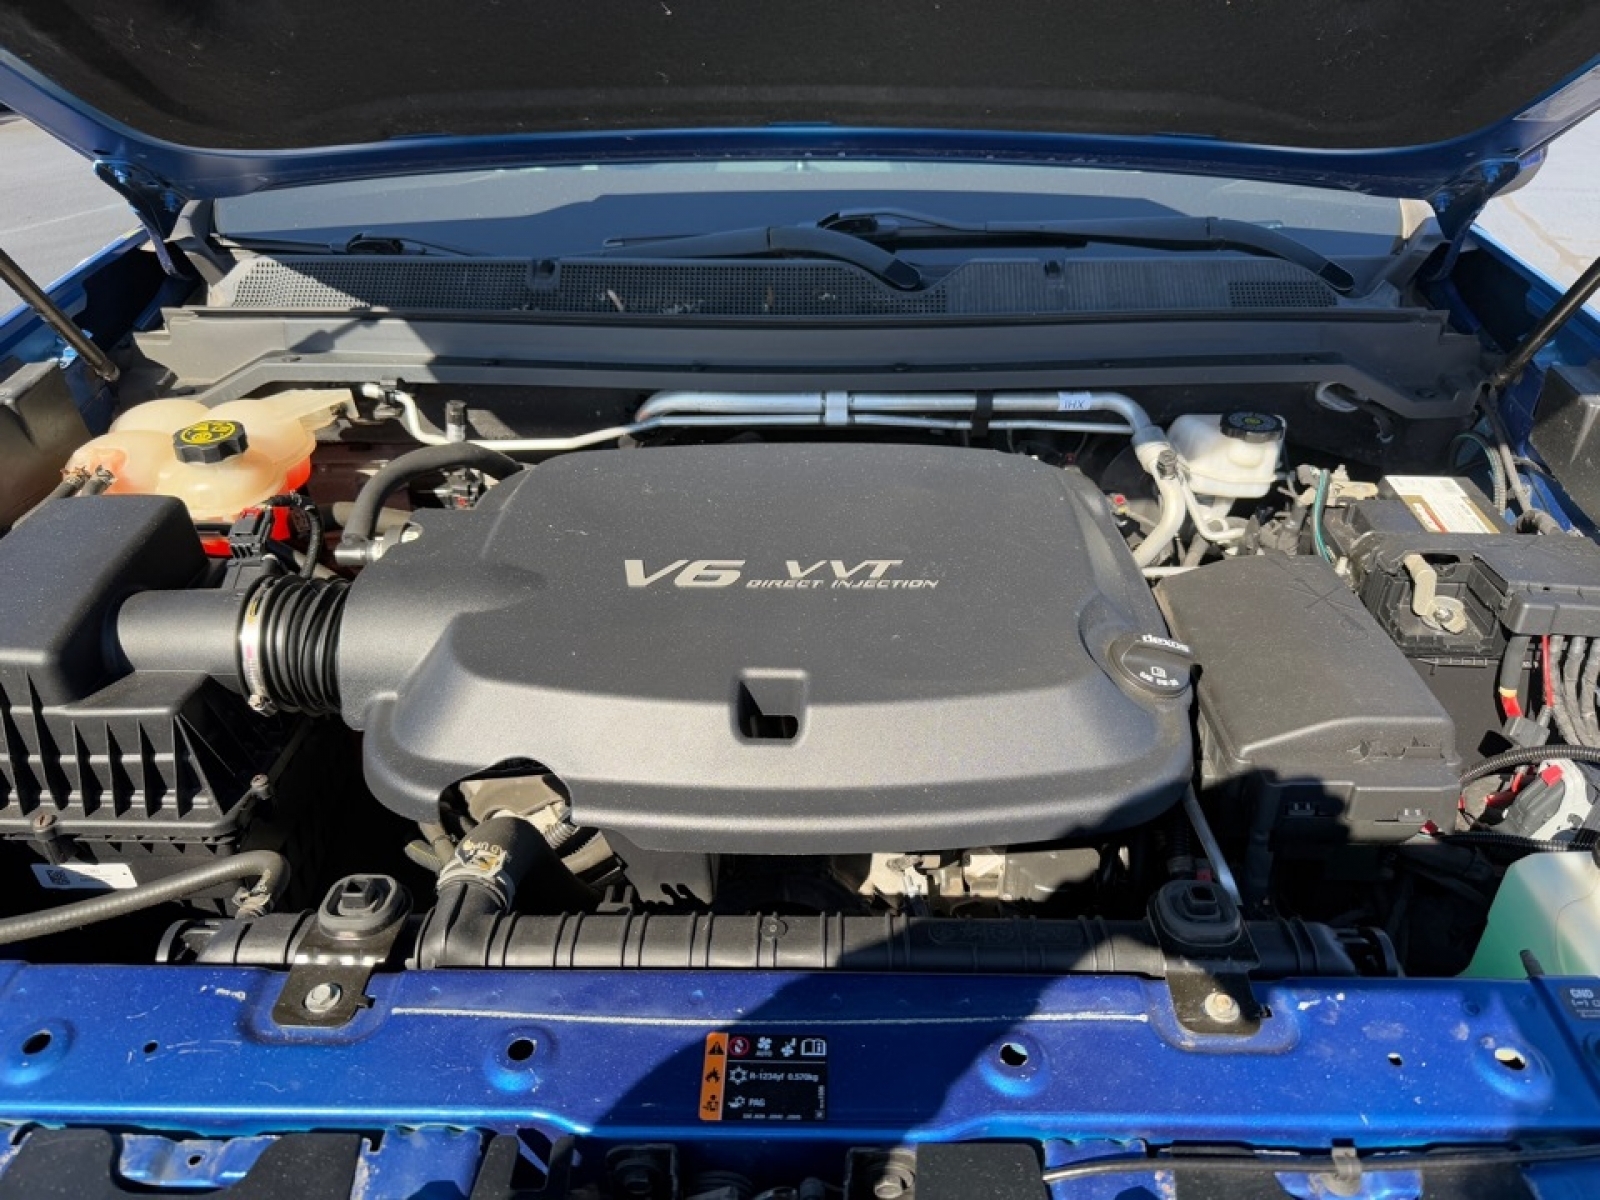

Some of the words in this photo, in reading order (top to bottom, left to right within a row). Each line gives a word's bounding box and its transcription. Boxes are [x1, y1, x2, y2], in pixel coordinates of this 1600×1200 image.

[1064, 399, 1086, 409] IHX
[624, 559, 746, 588] V6
[785, 559, 904, 578] VVT
[746, 579, 824, 589] DIRECT
[831, 579, 939, 590] INJECTION
